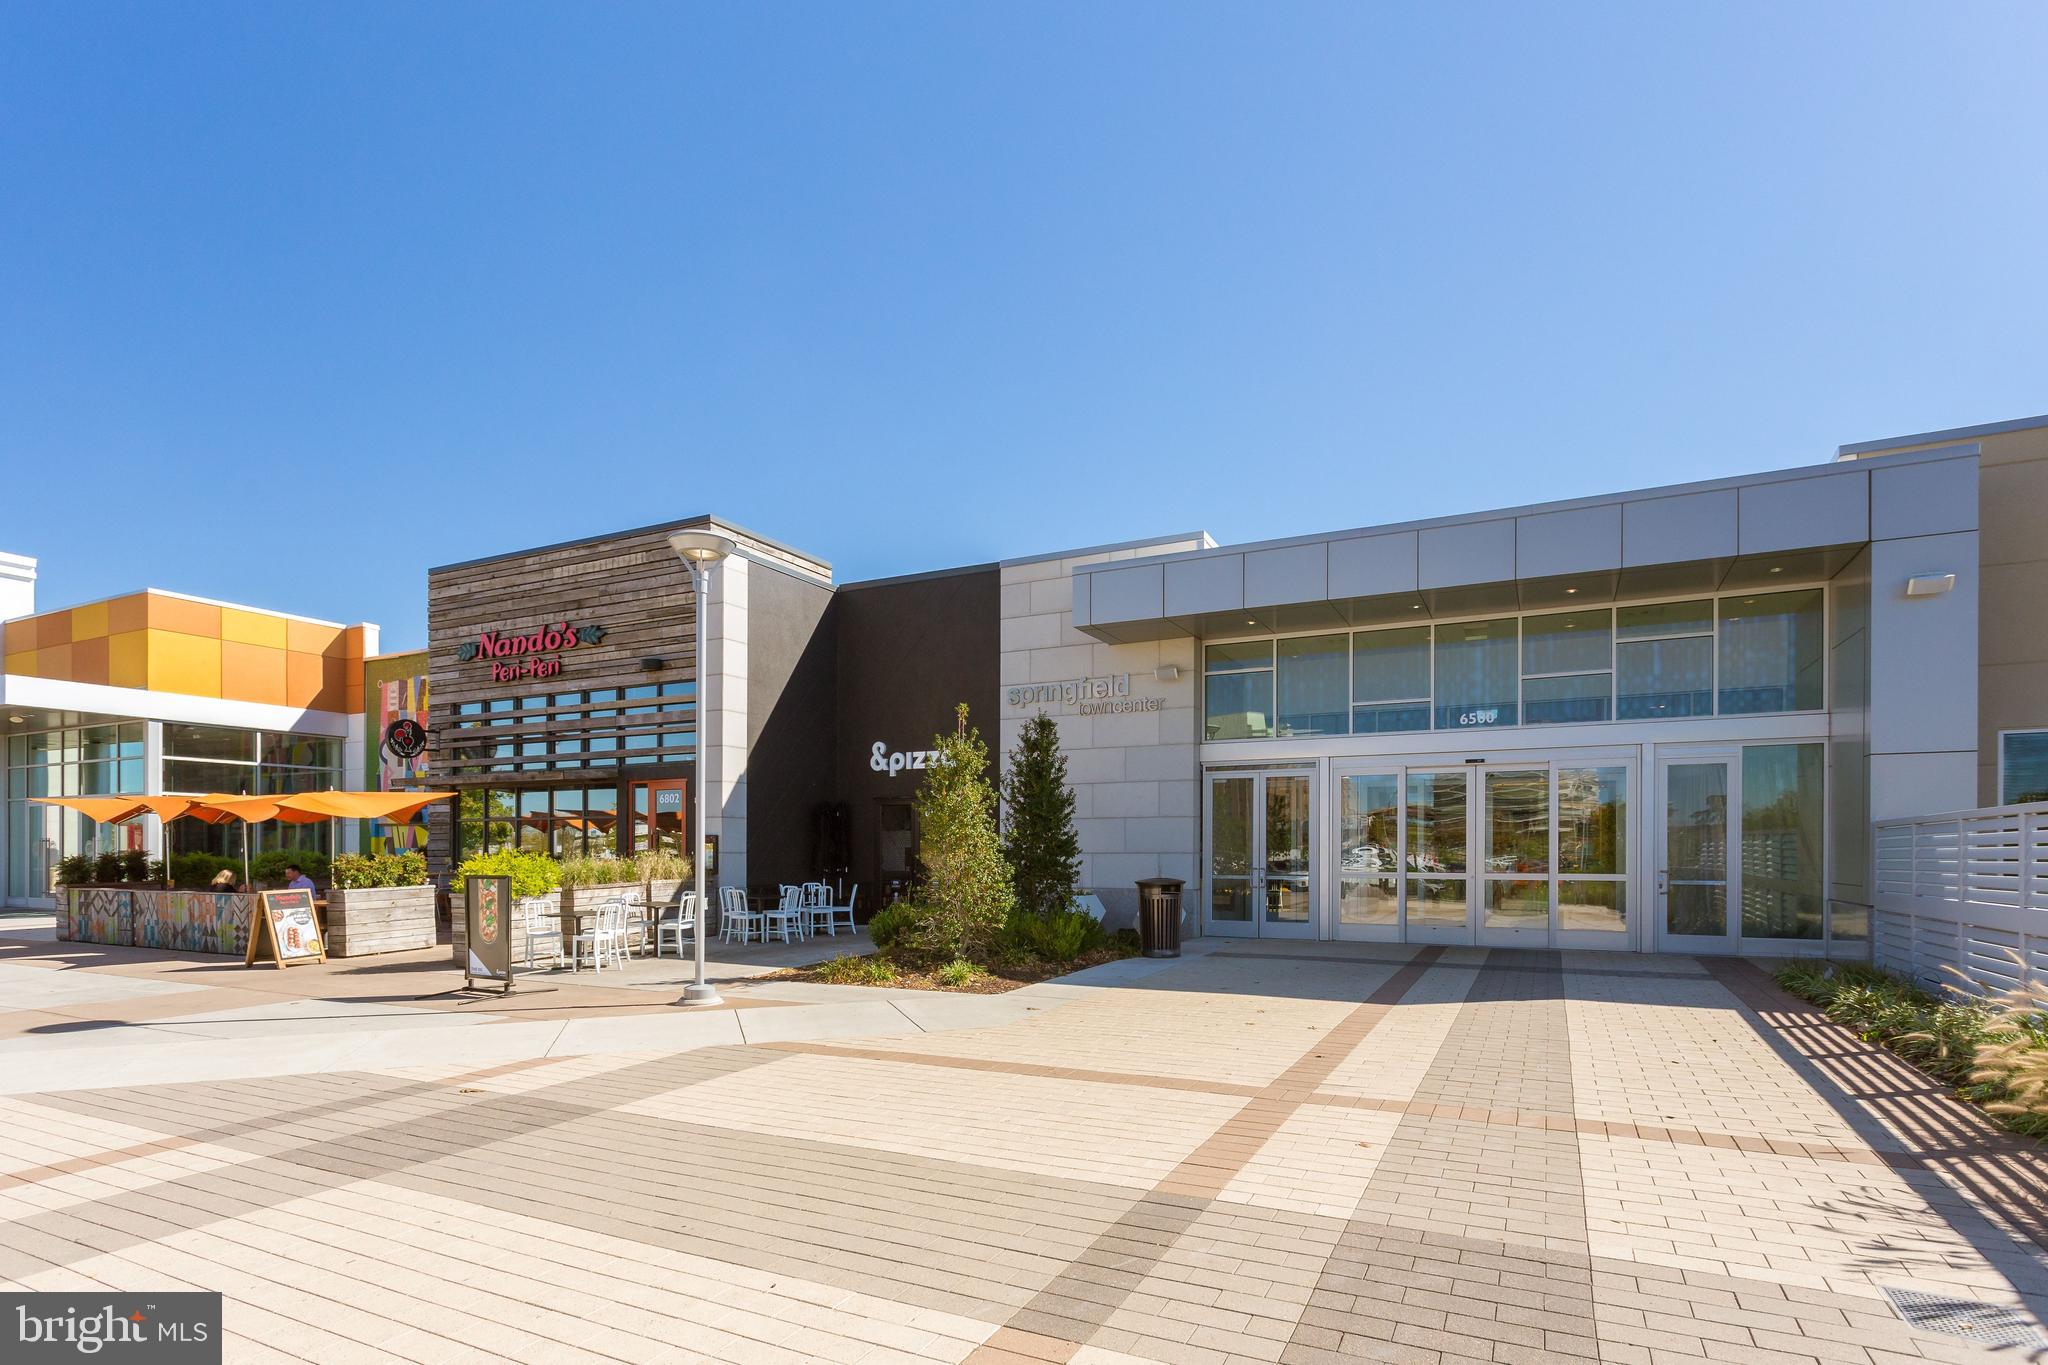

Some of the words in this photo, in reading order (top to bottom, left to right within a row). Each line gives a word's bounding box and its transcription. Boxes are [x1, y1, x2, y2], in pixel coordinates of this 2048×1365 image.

[477, 620, 577, 660] Nando's
[492, 656, 560, 682] Peri-Peri
[1007, 672, 1130, 709] springfield
[1079, 696, 1166, 716] towncenter
[1459, 711, 1495, 725] 6500
[659, 793, 680, 804] 6802
